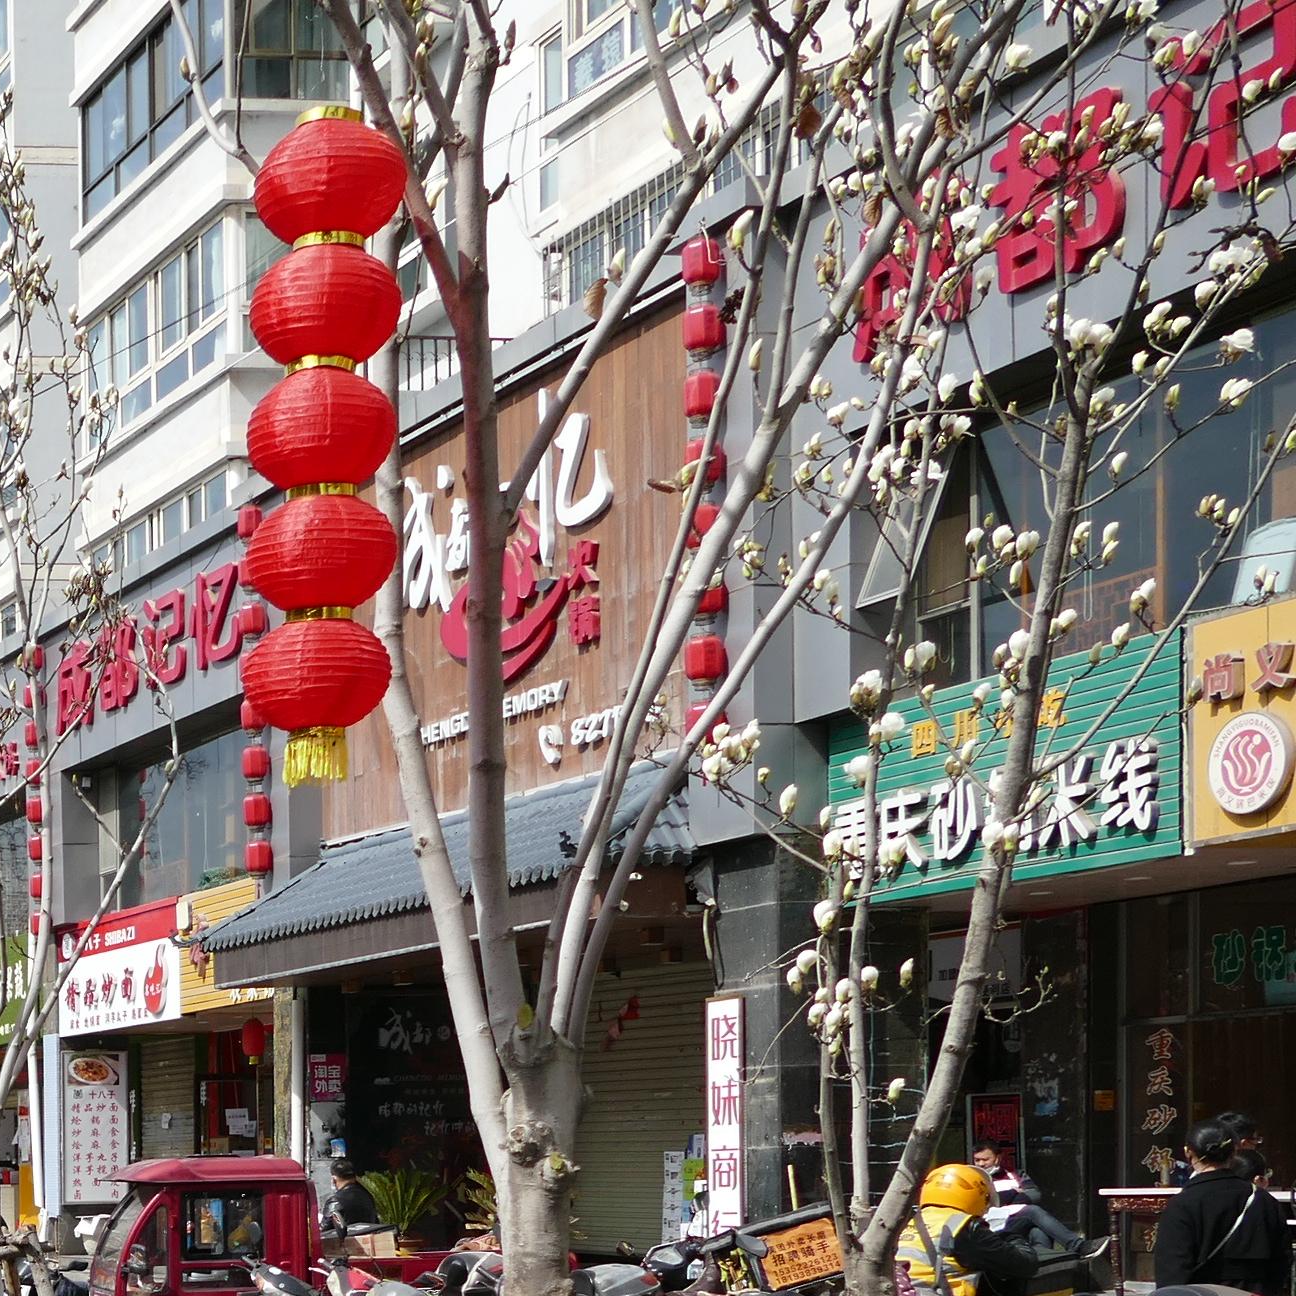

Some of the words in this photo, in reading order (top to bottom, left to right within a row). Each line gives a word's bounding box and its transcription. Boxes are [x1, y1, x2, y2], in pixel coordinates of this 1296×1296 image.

[568, 540, 600, 645] 火锅
[502, 679, 568, 719] EMORY
[79, 933, 101, 951] 八子
[105, 926, 135, 947] SHIBAZI
[64, 967, 135, 1013] 精品炒面
[314, 1065, 341, 1078] 淘宝
[89, 1090, 116, 1099] 十八子
[314, 1079, 341, 1093] 外卖
[71, 1103, 118, 1113] 精品炒面
[72, 1152, 118, 1163] 洋芋丸子
[772, 1240, 830, 1267] 招聘骑手
